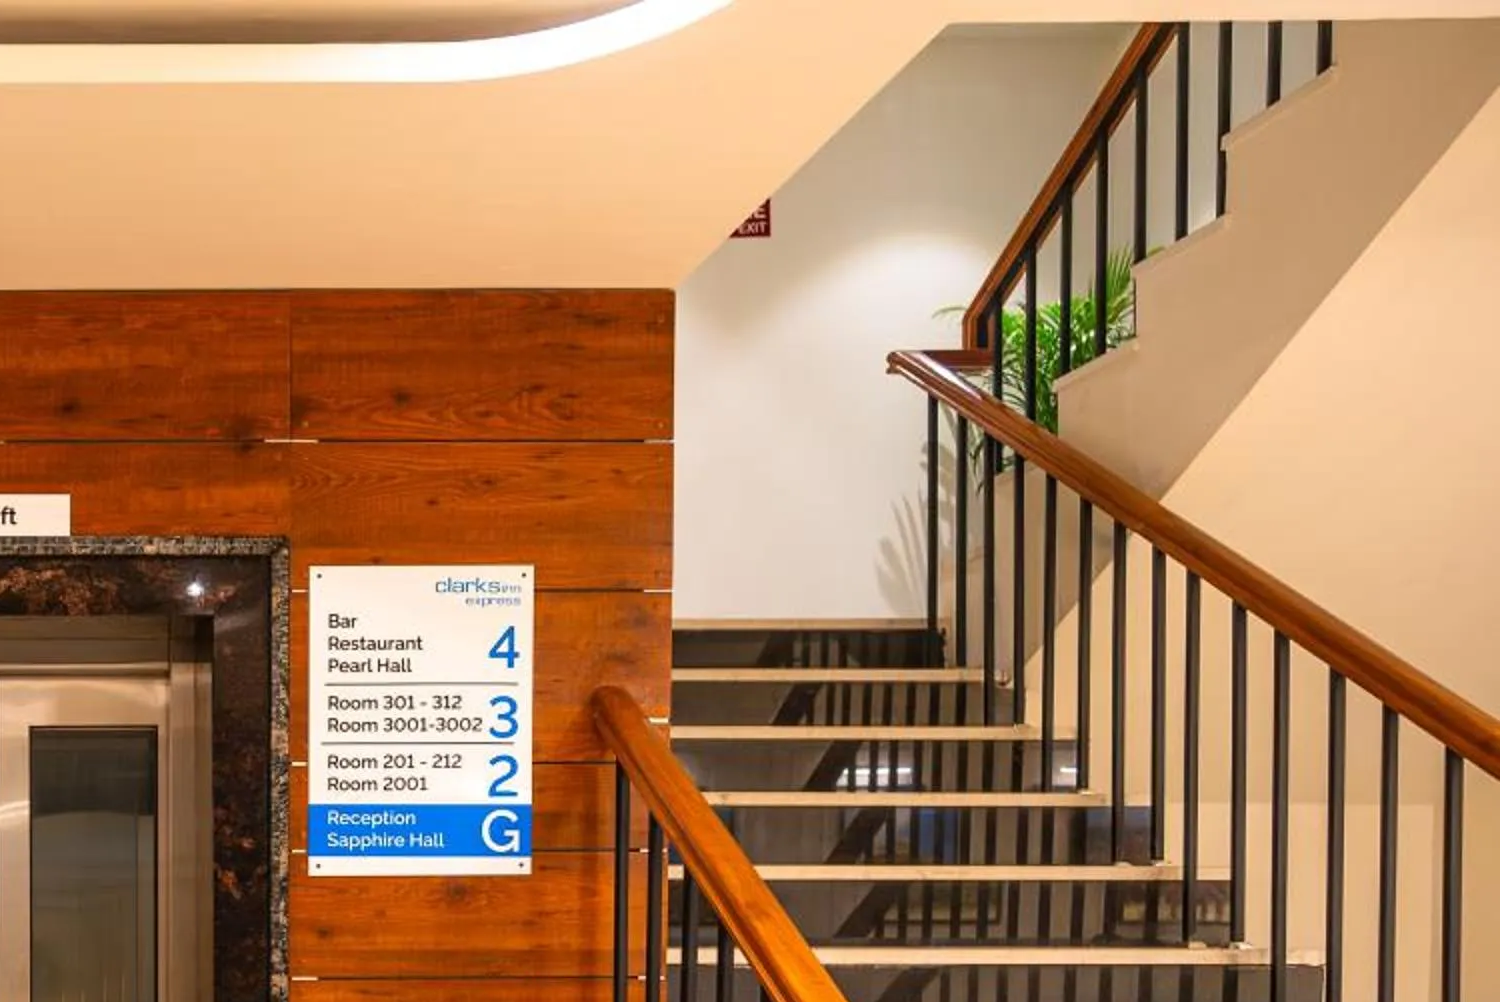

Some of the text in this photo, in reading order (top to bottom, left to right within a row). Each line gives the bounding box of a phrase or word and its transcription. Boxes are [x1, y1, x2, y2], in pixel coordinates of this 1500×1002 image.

[435, 577, 501, 593] clarks
[327, 613, 357, 629] Bar
[327, 636, 423, 651] Restaurant
[488, 625, 520, 668] 4
[327, 658, 412, 673] Pearl Hall
[327, 695, 378, 710] Room
[383, 695, 415, 710] 301
[432, 695, 463, 710] 312
[327, 717, 483, 732] Room 3001-3002
[489, 695, 519, 739] 3
[327, 754, 378, 769] Room
[383, 754, 415, 769] 201
[432, 754, 463, 769] 212
[327, 776, 428, 791] Room 2001
[488, 754, 519, 798] 2
[327, 809, 416, 827] Reception
[481, 809, 521, 853] G
[327, 832, 444, 852] Sapphire Hall
